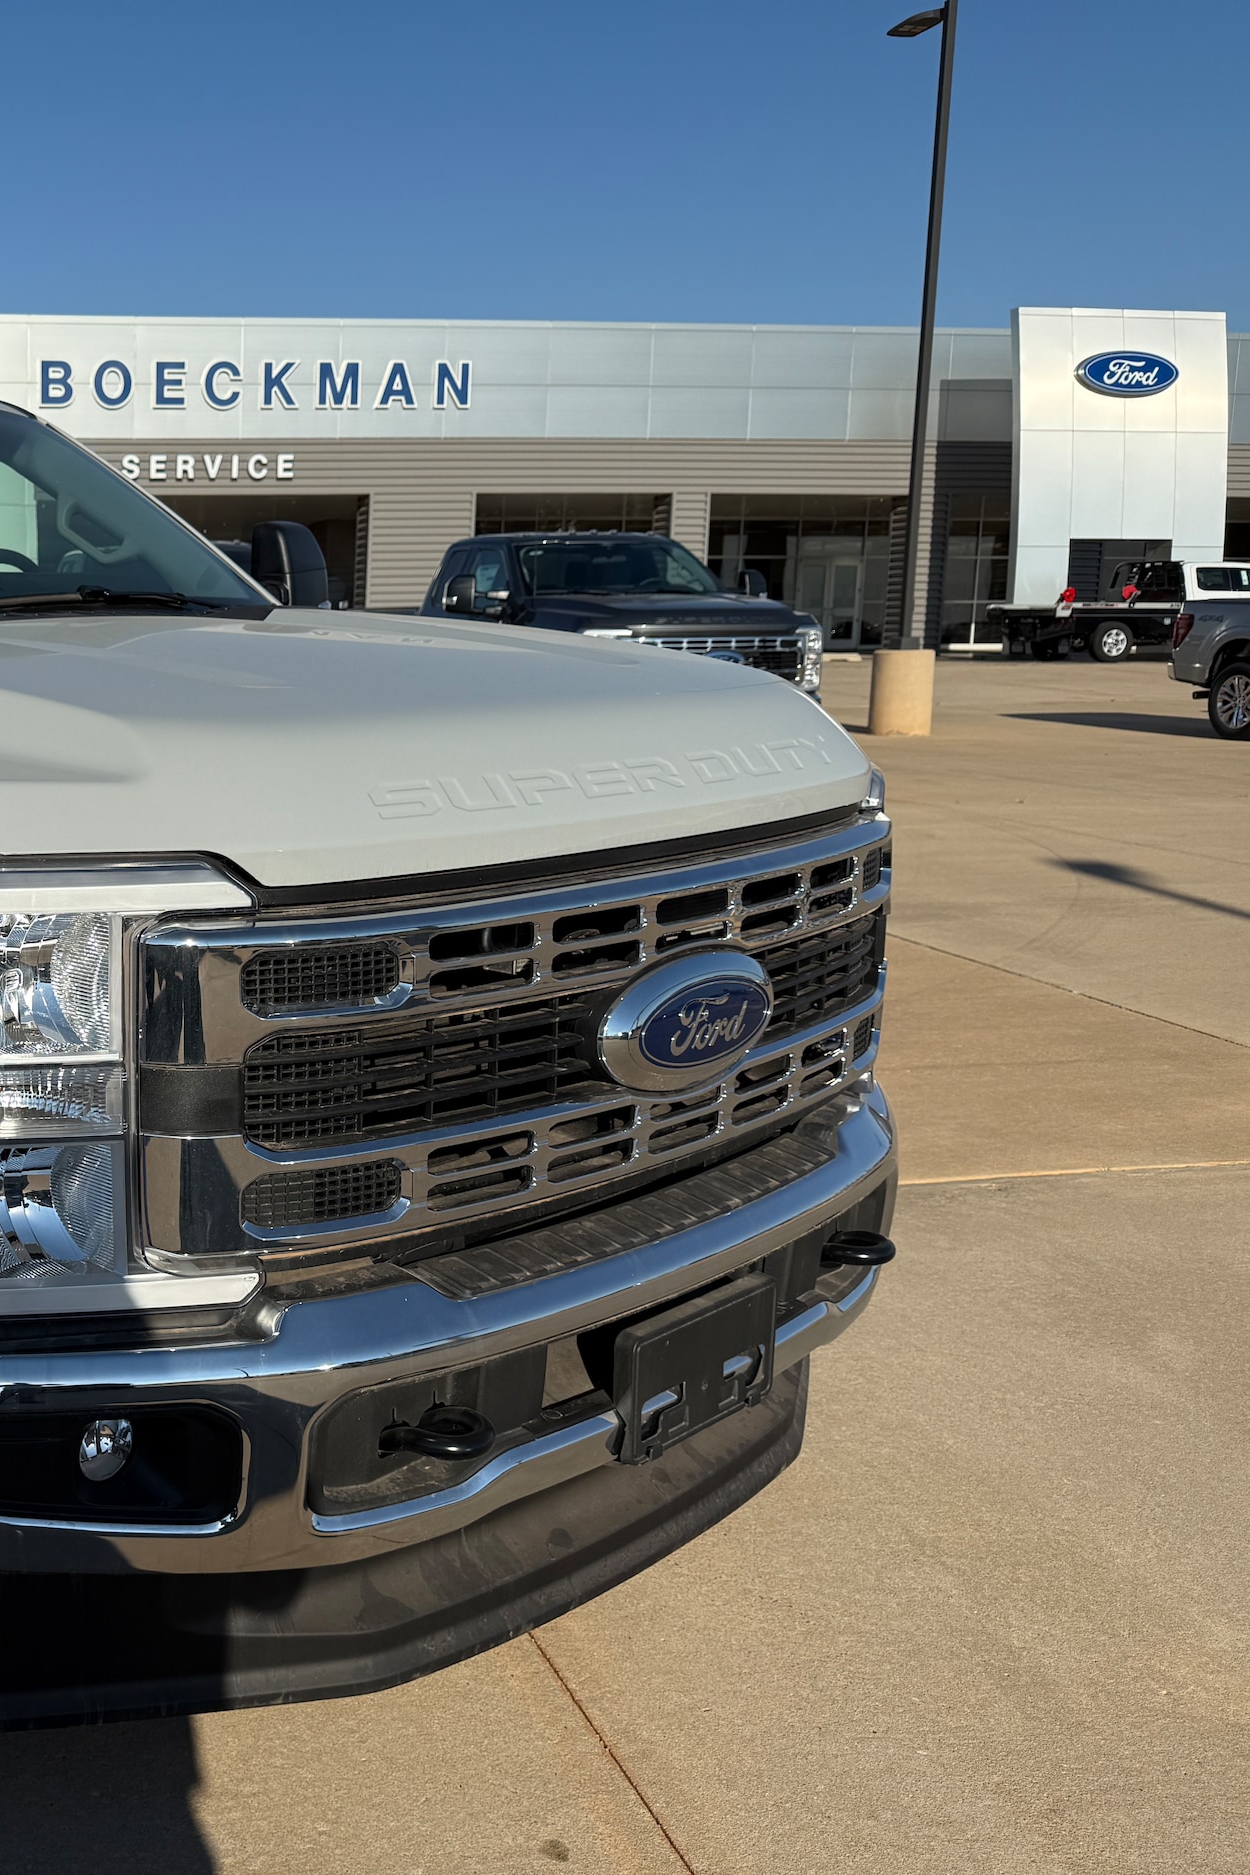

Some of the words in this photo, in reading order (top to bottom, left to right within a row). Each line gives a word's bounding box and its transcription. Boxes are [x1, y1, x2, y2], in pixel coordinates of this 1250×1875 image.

[39, 359, 474, 409] BOECKMAN
[1102, 359, 1159, 385] Ford
[121, 454, 296, 480] SERVICE
[368, 757, 686, 821] SUPER
[684, 734, 832, 784] DUTY
[670, 993, 755, 1057] Ford
